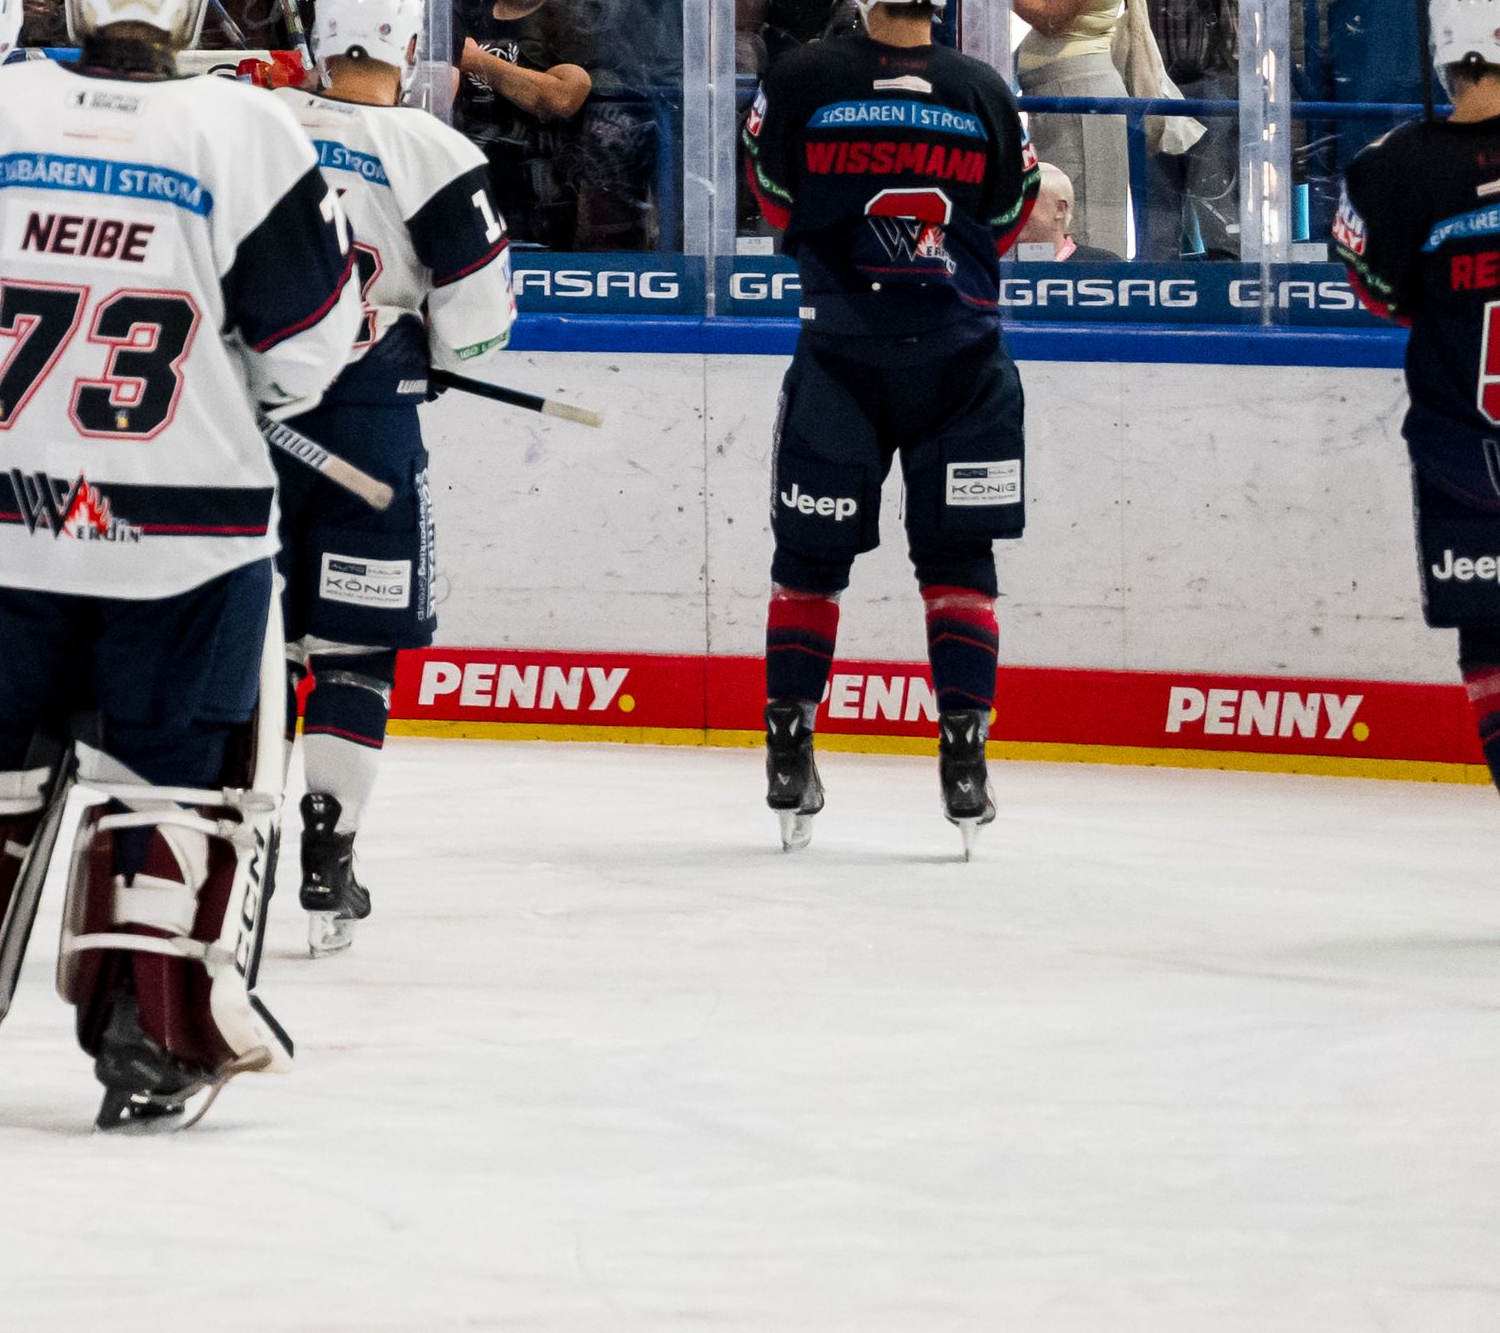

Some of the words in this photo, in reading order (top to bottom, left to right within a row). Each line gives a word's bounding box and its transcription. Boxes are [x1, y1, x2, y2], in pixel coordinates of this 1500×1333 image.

[805, 140, 987, 186] WISSMANN
[511, 267, 681, 300] ASAG
[999, 277, 1198, 308] GASAG
[1228, 279, 1360, 311] GAS
[780, 482, 858, 522] Jeep
[951, 480, 1017, 495] KÖNIG
[1431, 549, 1500, 583] Jee
[325, 576, 406, 598] KÖNIG
